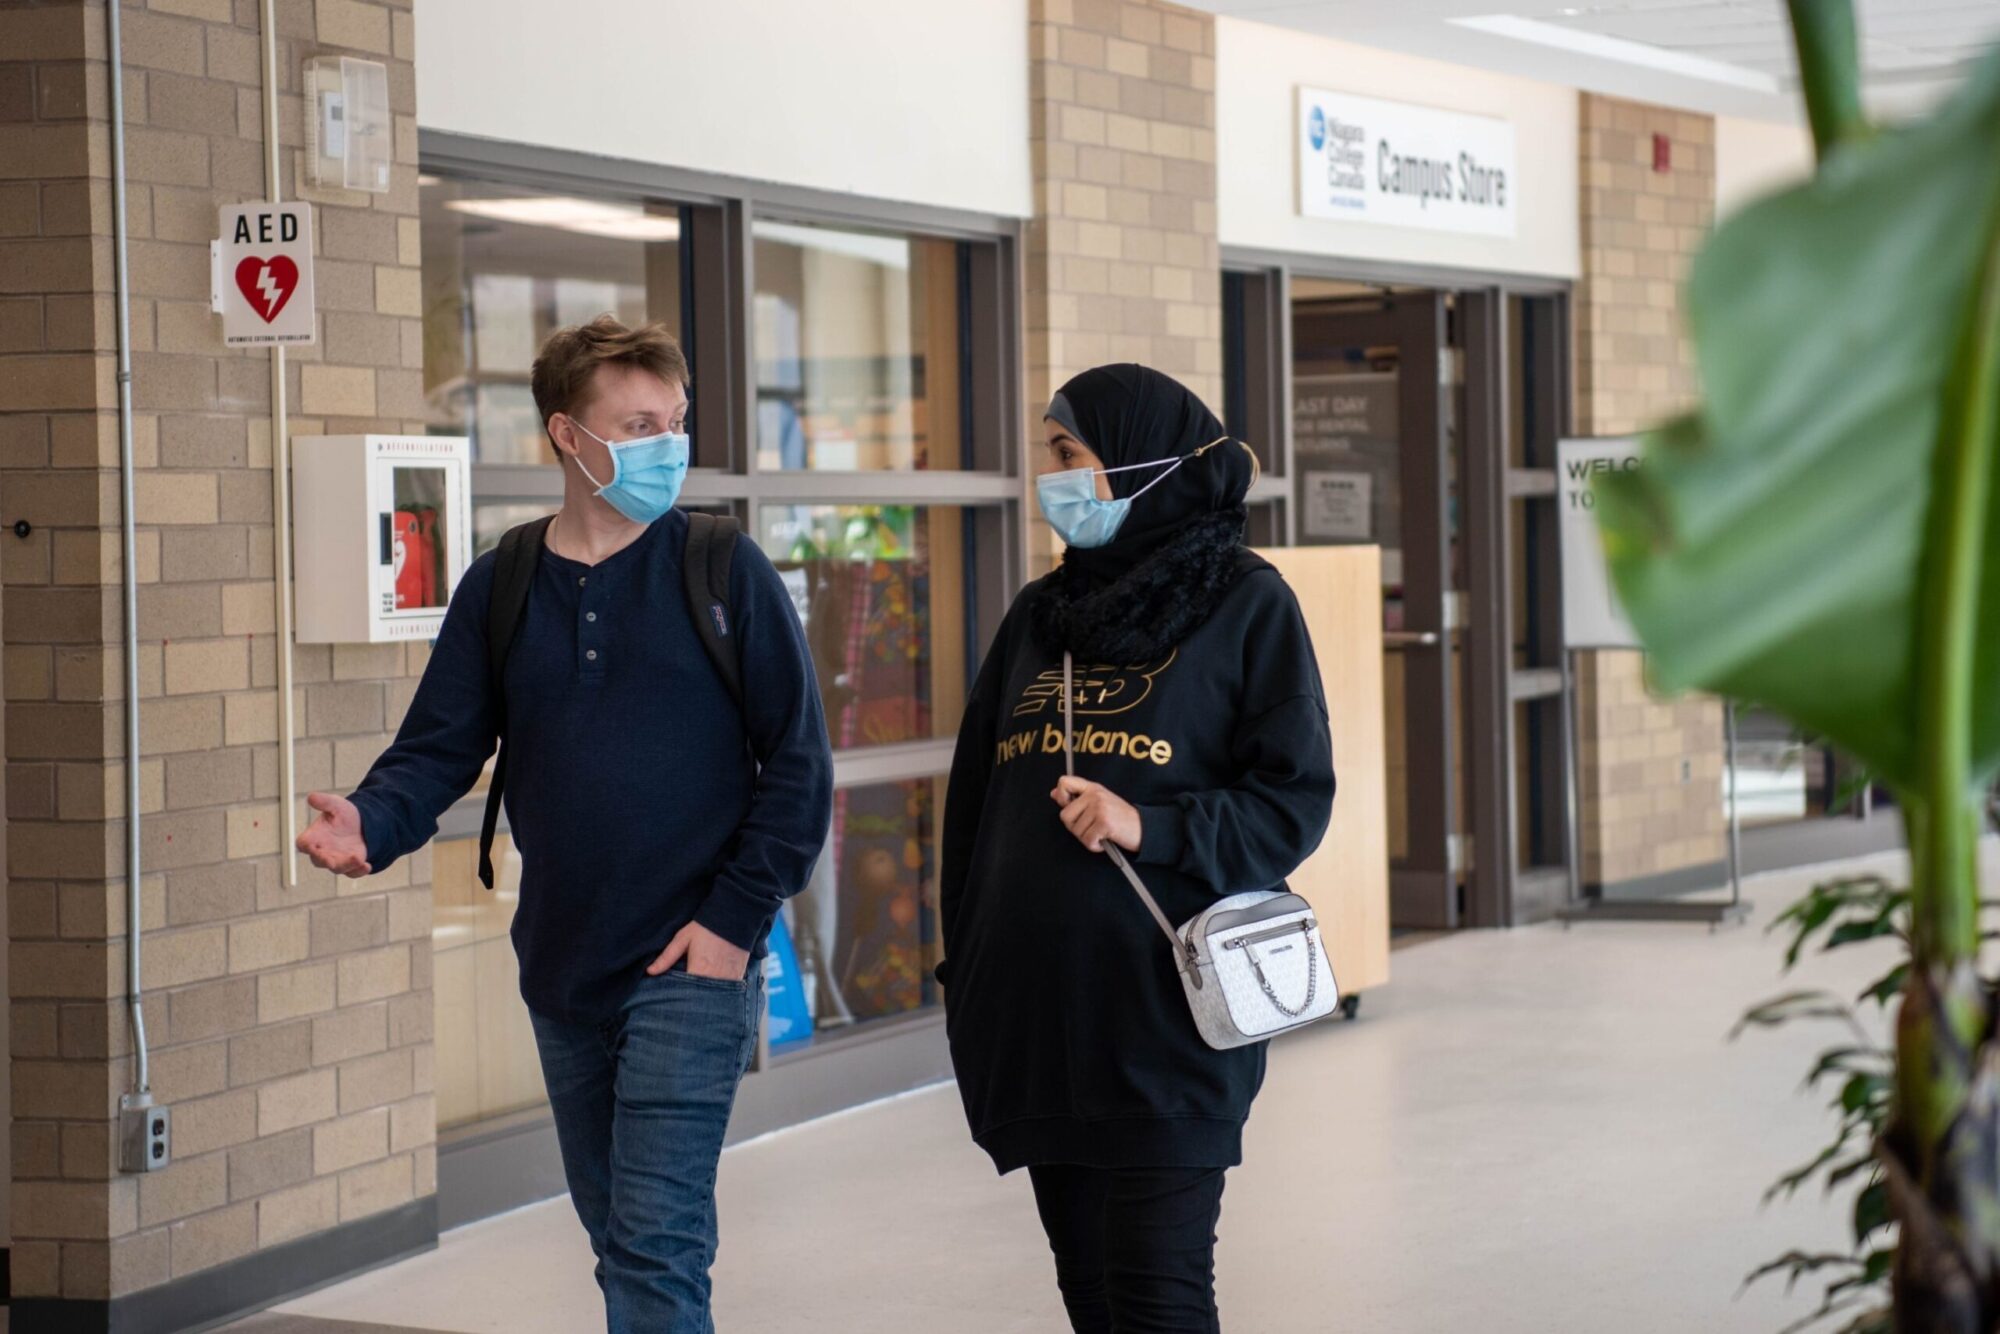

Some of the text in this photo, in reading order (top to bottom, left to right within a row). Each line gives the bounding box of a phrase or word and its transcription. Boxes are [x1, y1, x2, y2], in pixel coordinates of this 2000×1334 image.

[1378, 138, 1507, 209] Campus Store
[234, 213, 298, 244] AED
[1332, 396, 1367, 414] DAY
[1566, 456, 1641, 481] WELC
[1568, 490, 1595, 511] TO
[997, 722, 1173, 766] new balance
